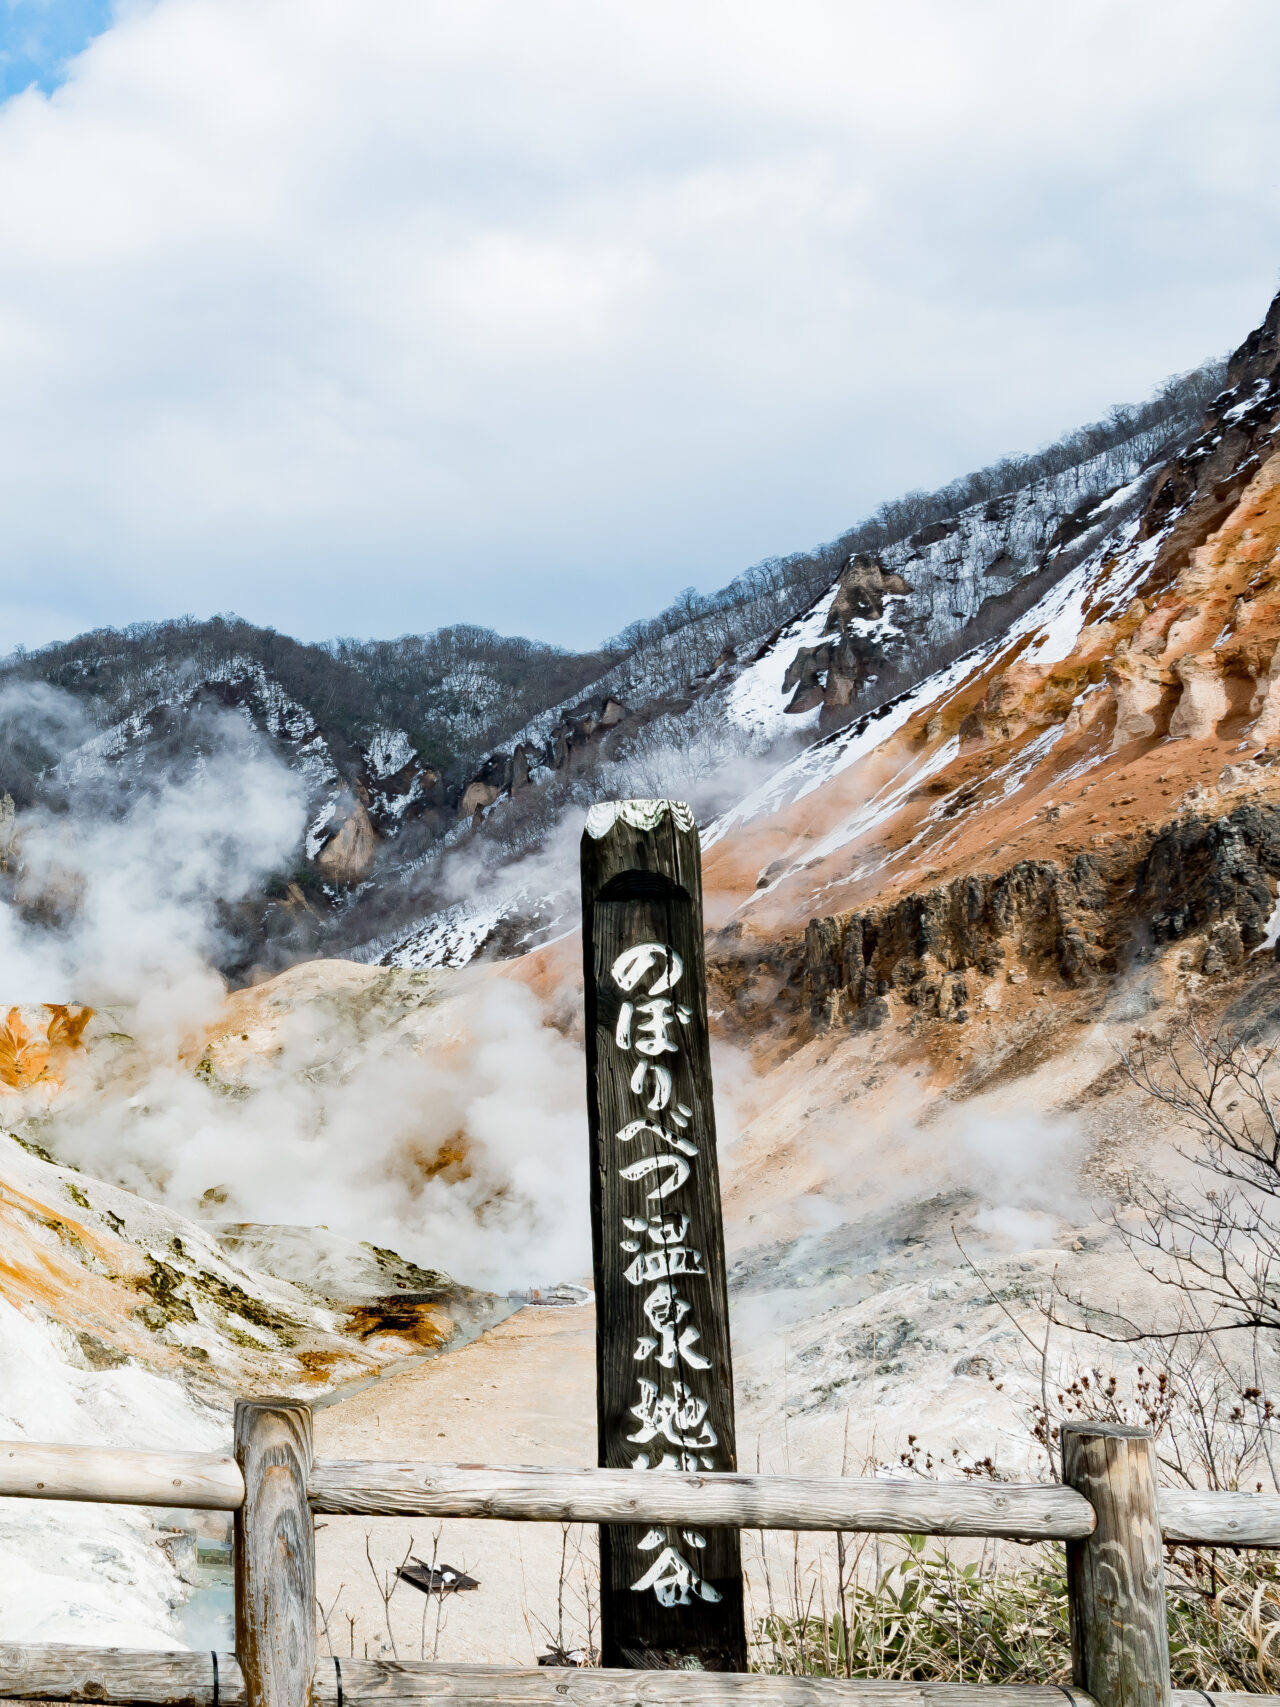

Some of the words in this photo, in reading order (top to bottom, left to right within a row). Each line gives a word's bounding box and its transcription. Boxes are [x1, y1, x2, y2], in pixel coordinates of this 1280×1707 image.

[611, 943, 723, 1608] のぼりべつ温泉地谷
